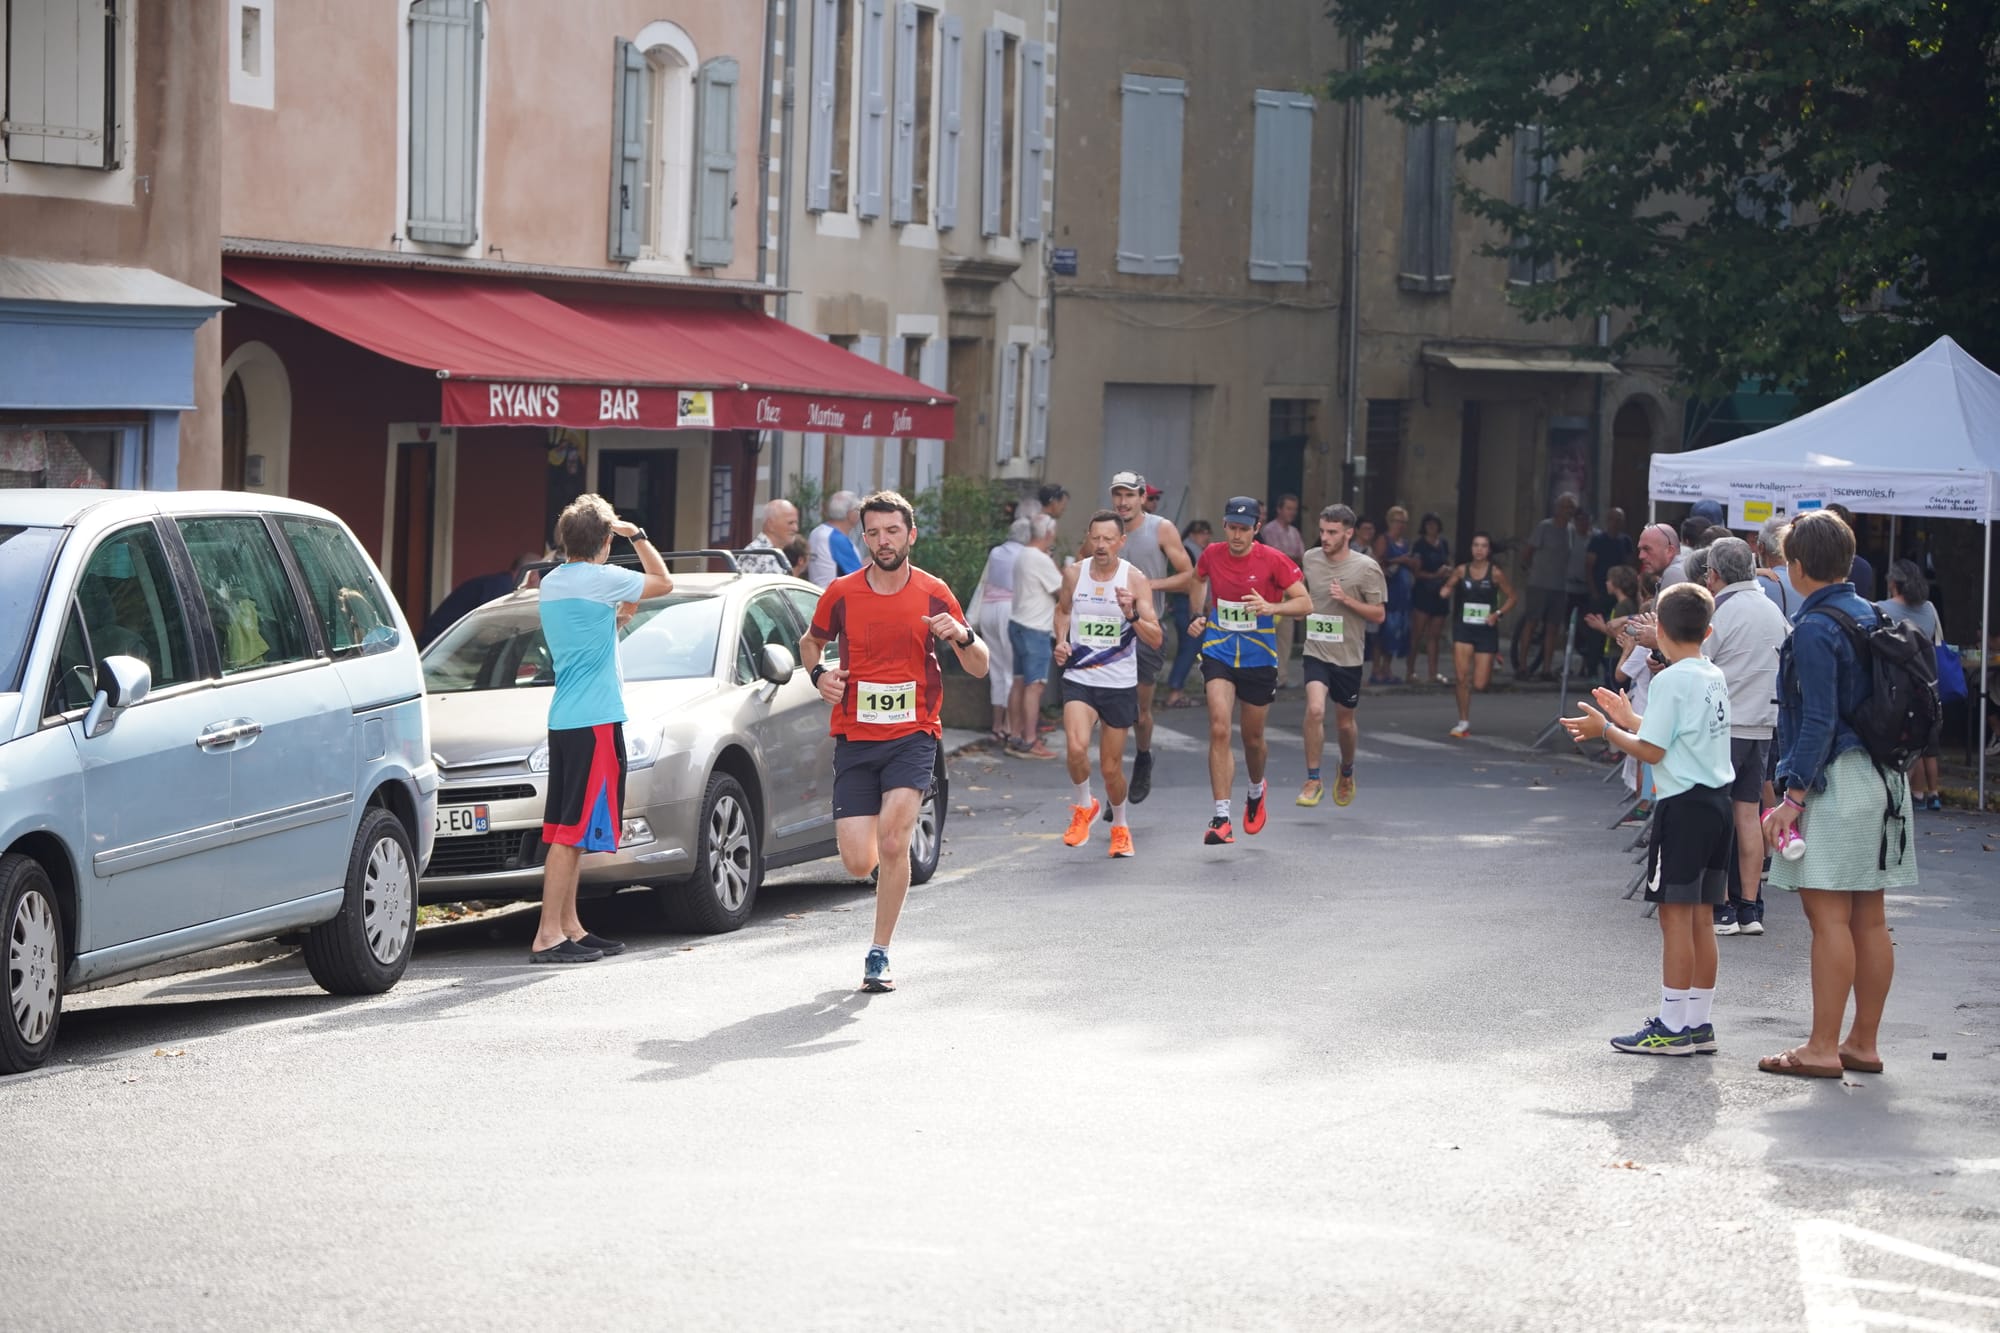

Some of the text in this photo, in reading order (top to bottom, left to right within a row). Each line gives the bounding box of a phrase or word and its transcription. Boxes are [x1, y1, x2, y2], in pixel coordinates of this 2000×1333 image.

[489, 384, 640, 420] RYAN'S BAR
[756, 396, 781, 423] Chez
[806, 403, 846, 428] Martine
[862, 411, 873, 429] et
[1222, 608, 1249, 621] 111
[1085, 622, 1115, 637] 122
[1316, 621, 1333, 633] 33
[866, 693, 906, 711] 191
[476, 819, 487, 830] 48
